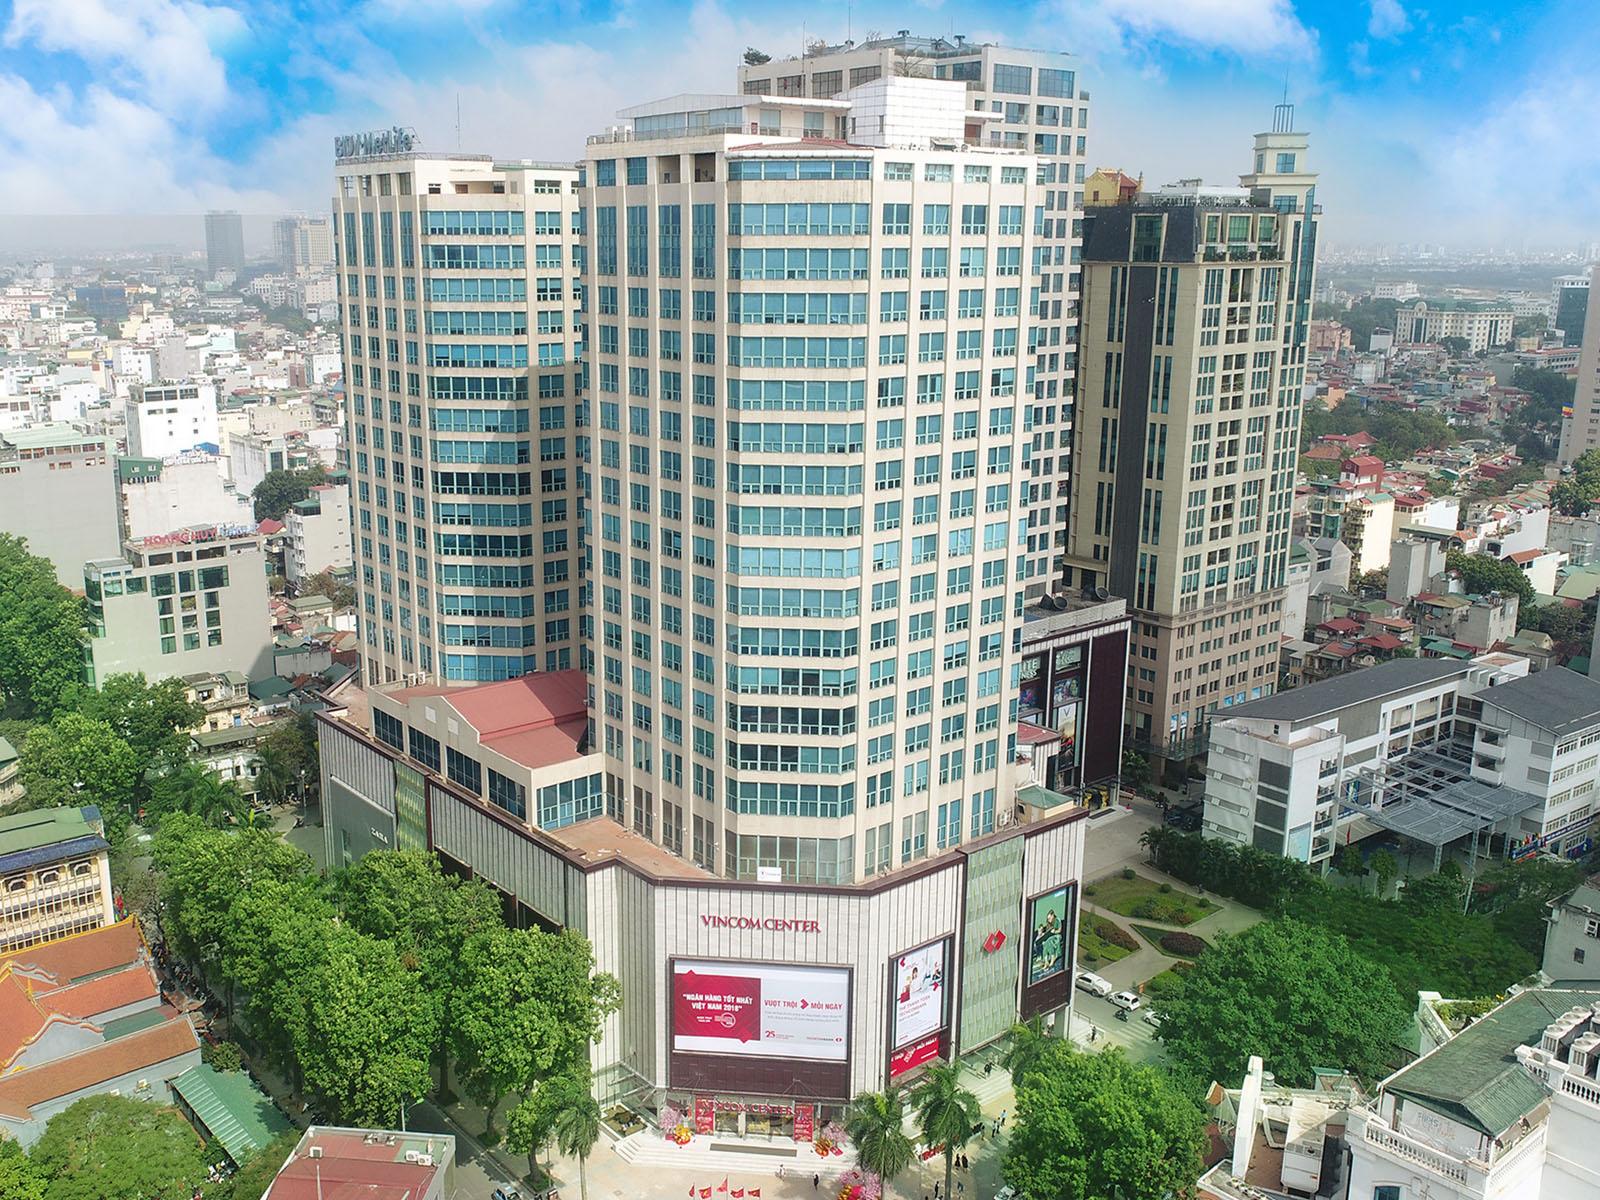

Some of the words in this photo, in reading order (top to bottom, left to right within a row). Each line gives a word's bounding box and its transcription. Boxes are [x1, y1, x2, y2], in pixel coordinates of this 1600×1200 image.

[371, 827, 388, 844] ZARA
[700, 914, 762, 930] VINCOM
[763, 917, 821, 933] CENTER
[750, 1102, 796, 1116] CENTER
